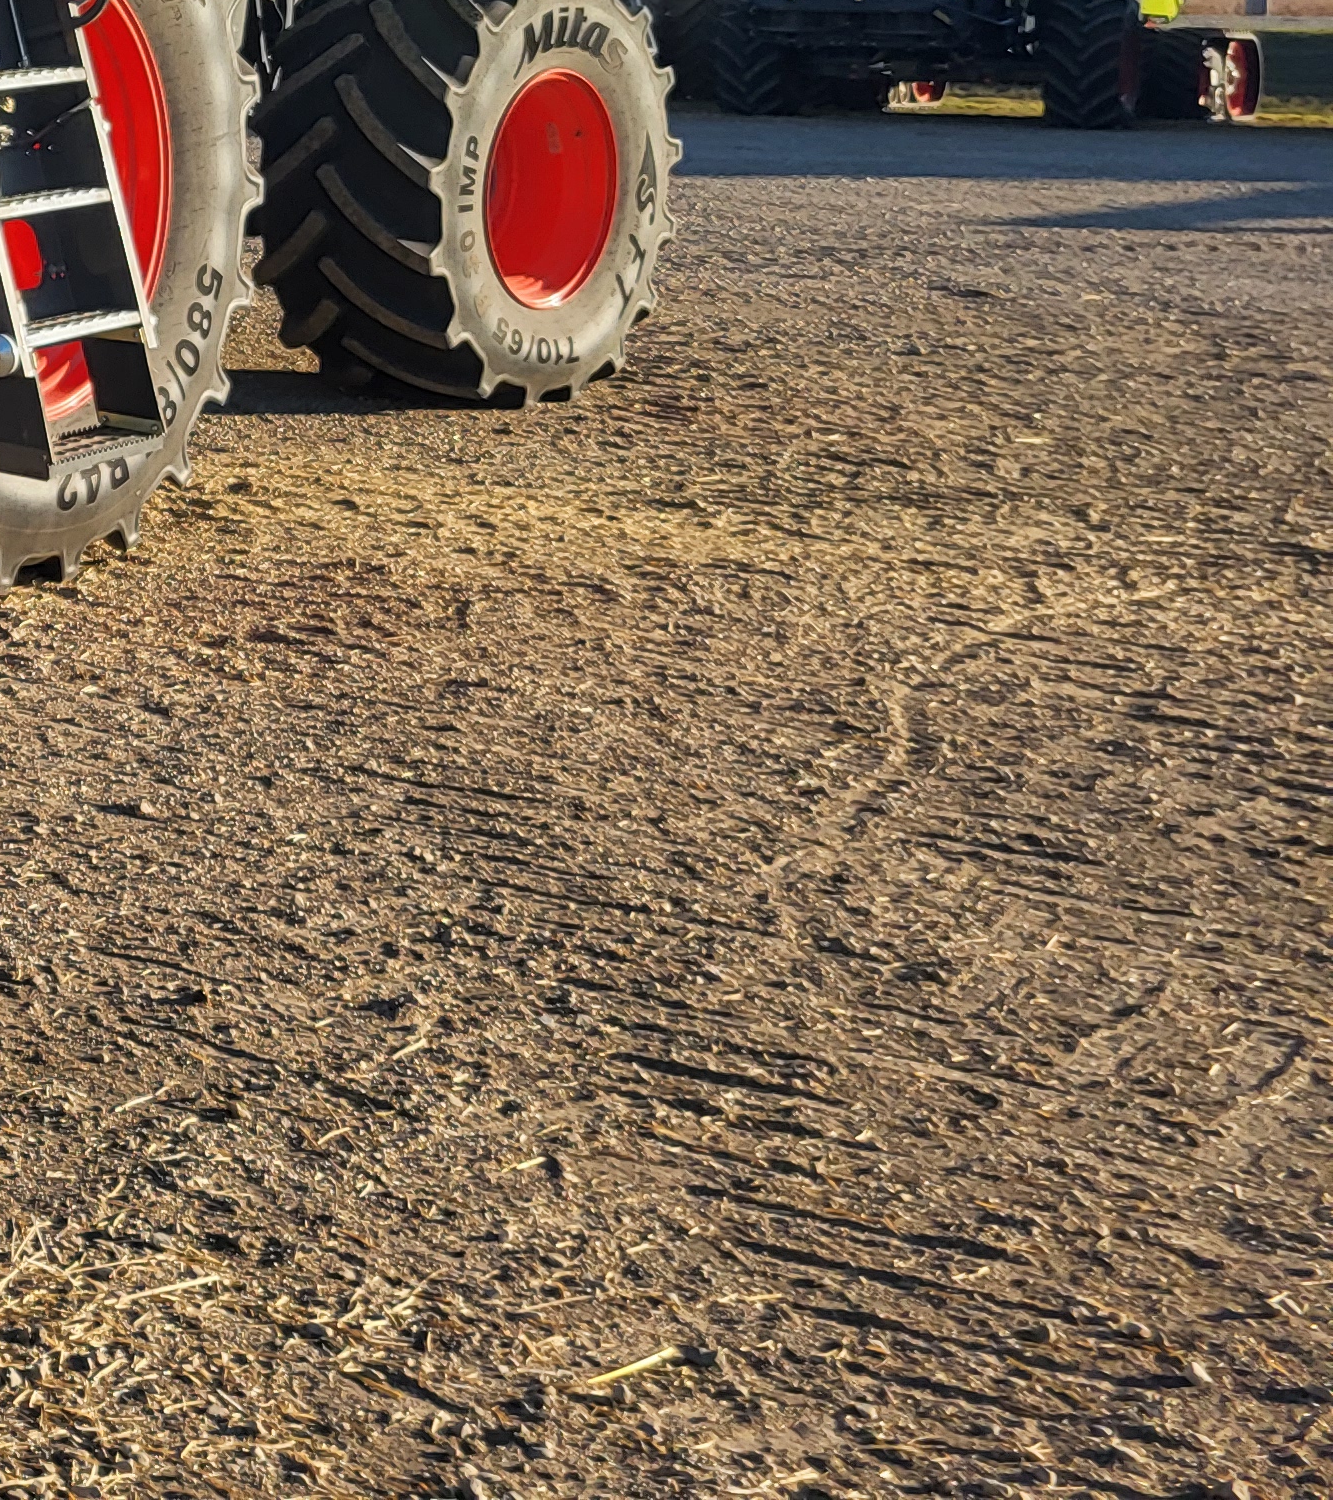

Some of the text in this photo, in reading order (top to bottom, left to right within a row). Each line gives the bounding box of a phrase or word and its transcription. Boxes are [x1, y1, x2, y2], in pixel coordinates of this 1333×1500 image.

[513, 6, 629, 82] Mitas
[155, 262, 224, 429] 580/8
[491, 316, 581, 365] 710/65
